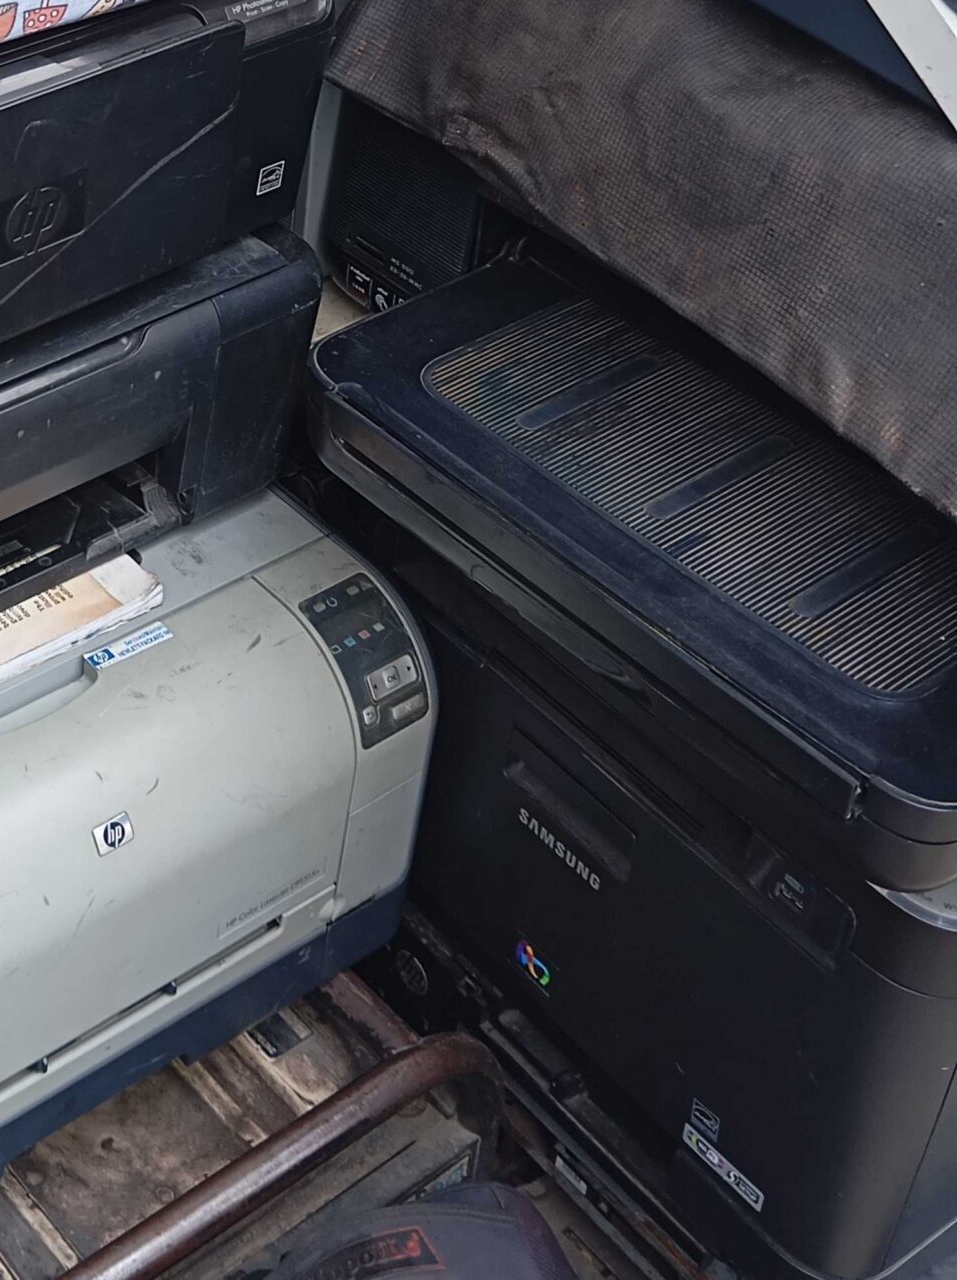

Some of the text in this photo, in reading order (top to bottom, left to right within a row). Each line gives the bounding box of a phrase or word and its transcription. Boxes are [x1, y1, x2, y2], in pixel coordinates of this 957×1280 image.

[232, 5, 242, 14] HP
[10, 186, 62, 257] hp
[518, 807, 601, 891] SAMSUNG
